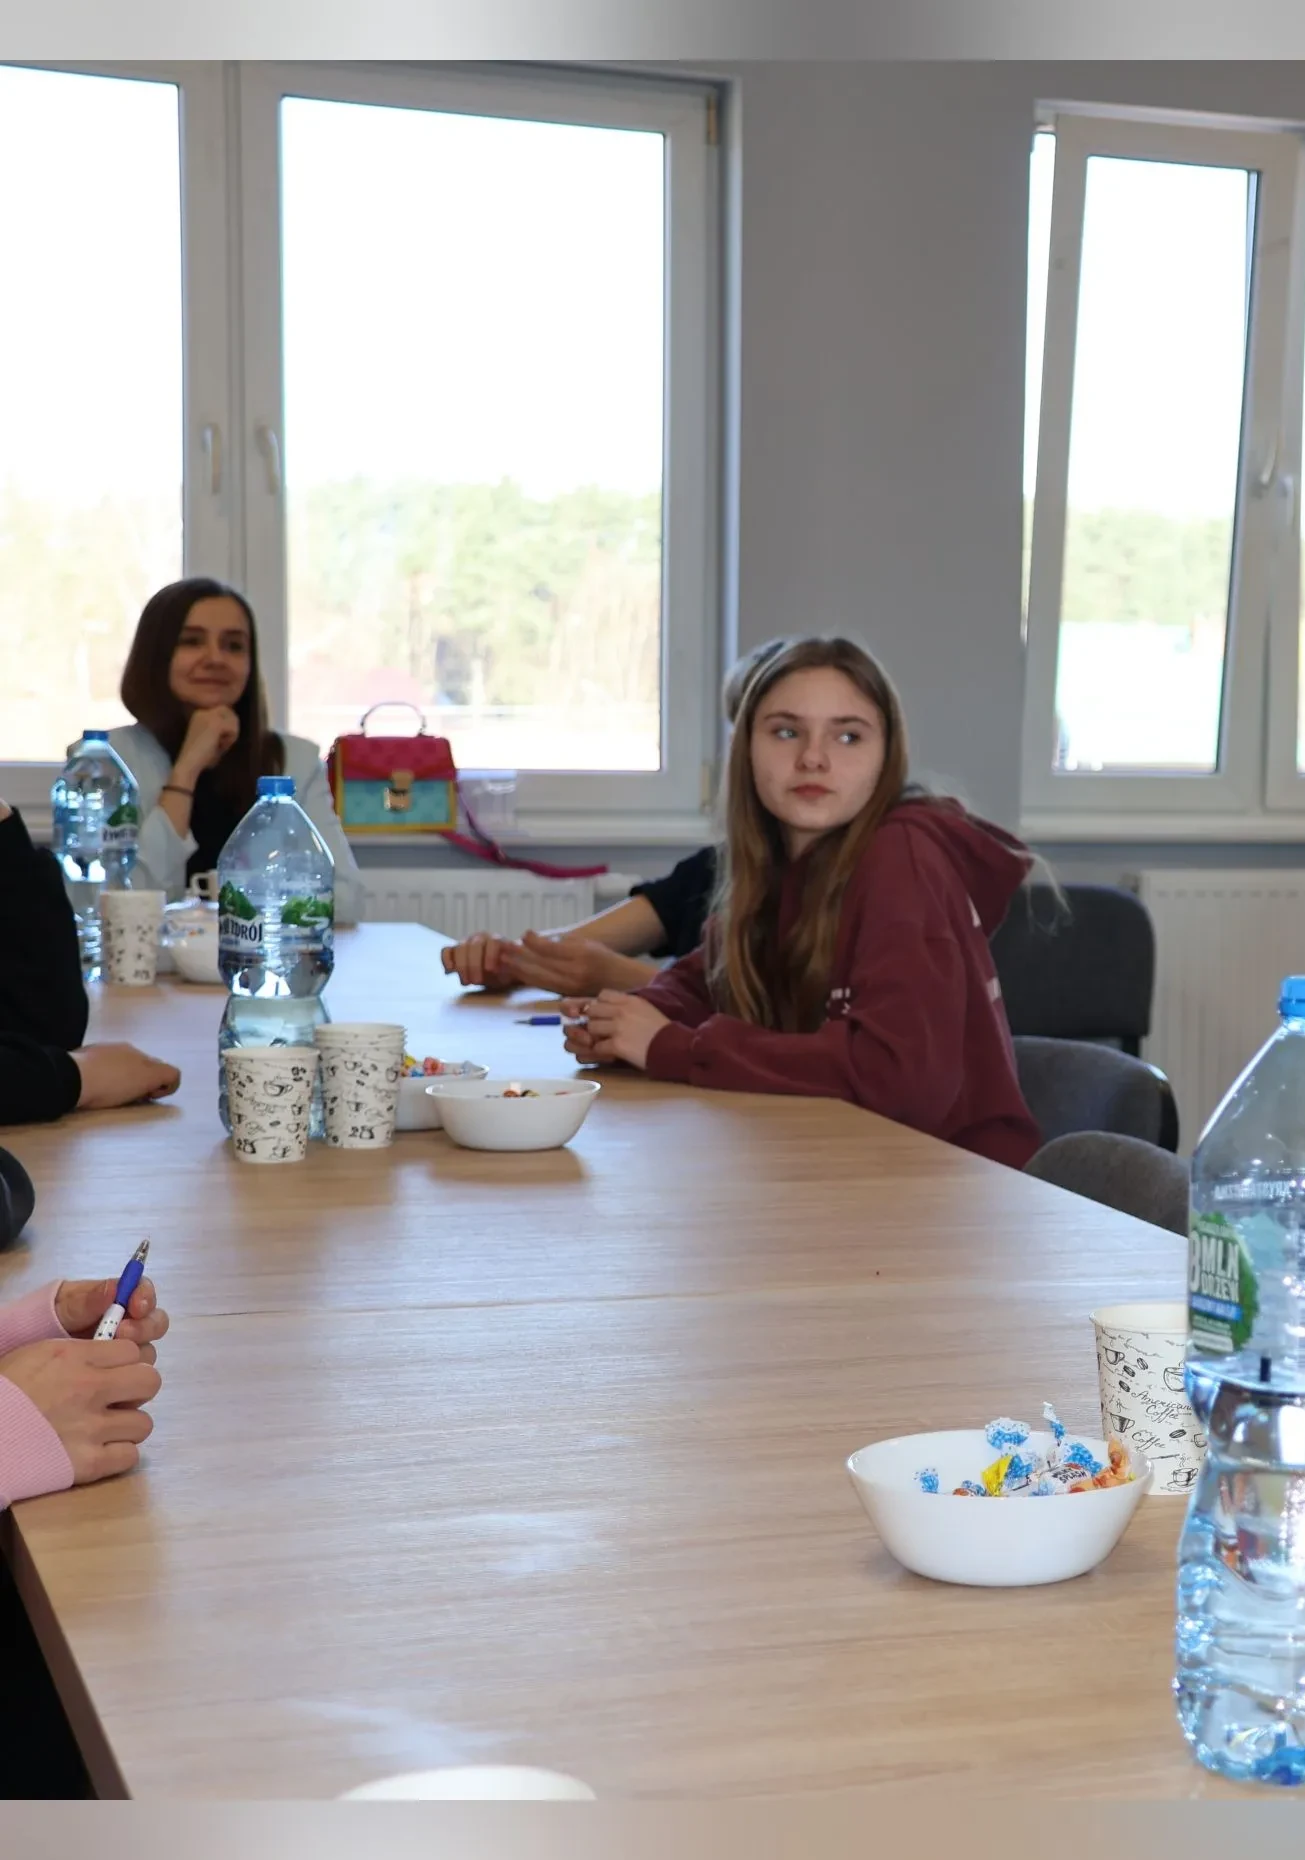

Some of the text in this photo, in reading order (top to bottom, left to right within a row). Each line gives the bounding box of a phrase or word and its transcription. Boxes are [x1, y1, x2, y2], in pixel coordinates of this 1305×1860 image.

[1201, 1234, 1240, 1281] MLN
[1146, 1404, 1179, 1424] Coffee
[1131, 1431, 1166, 1452] Coffee
